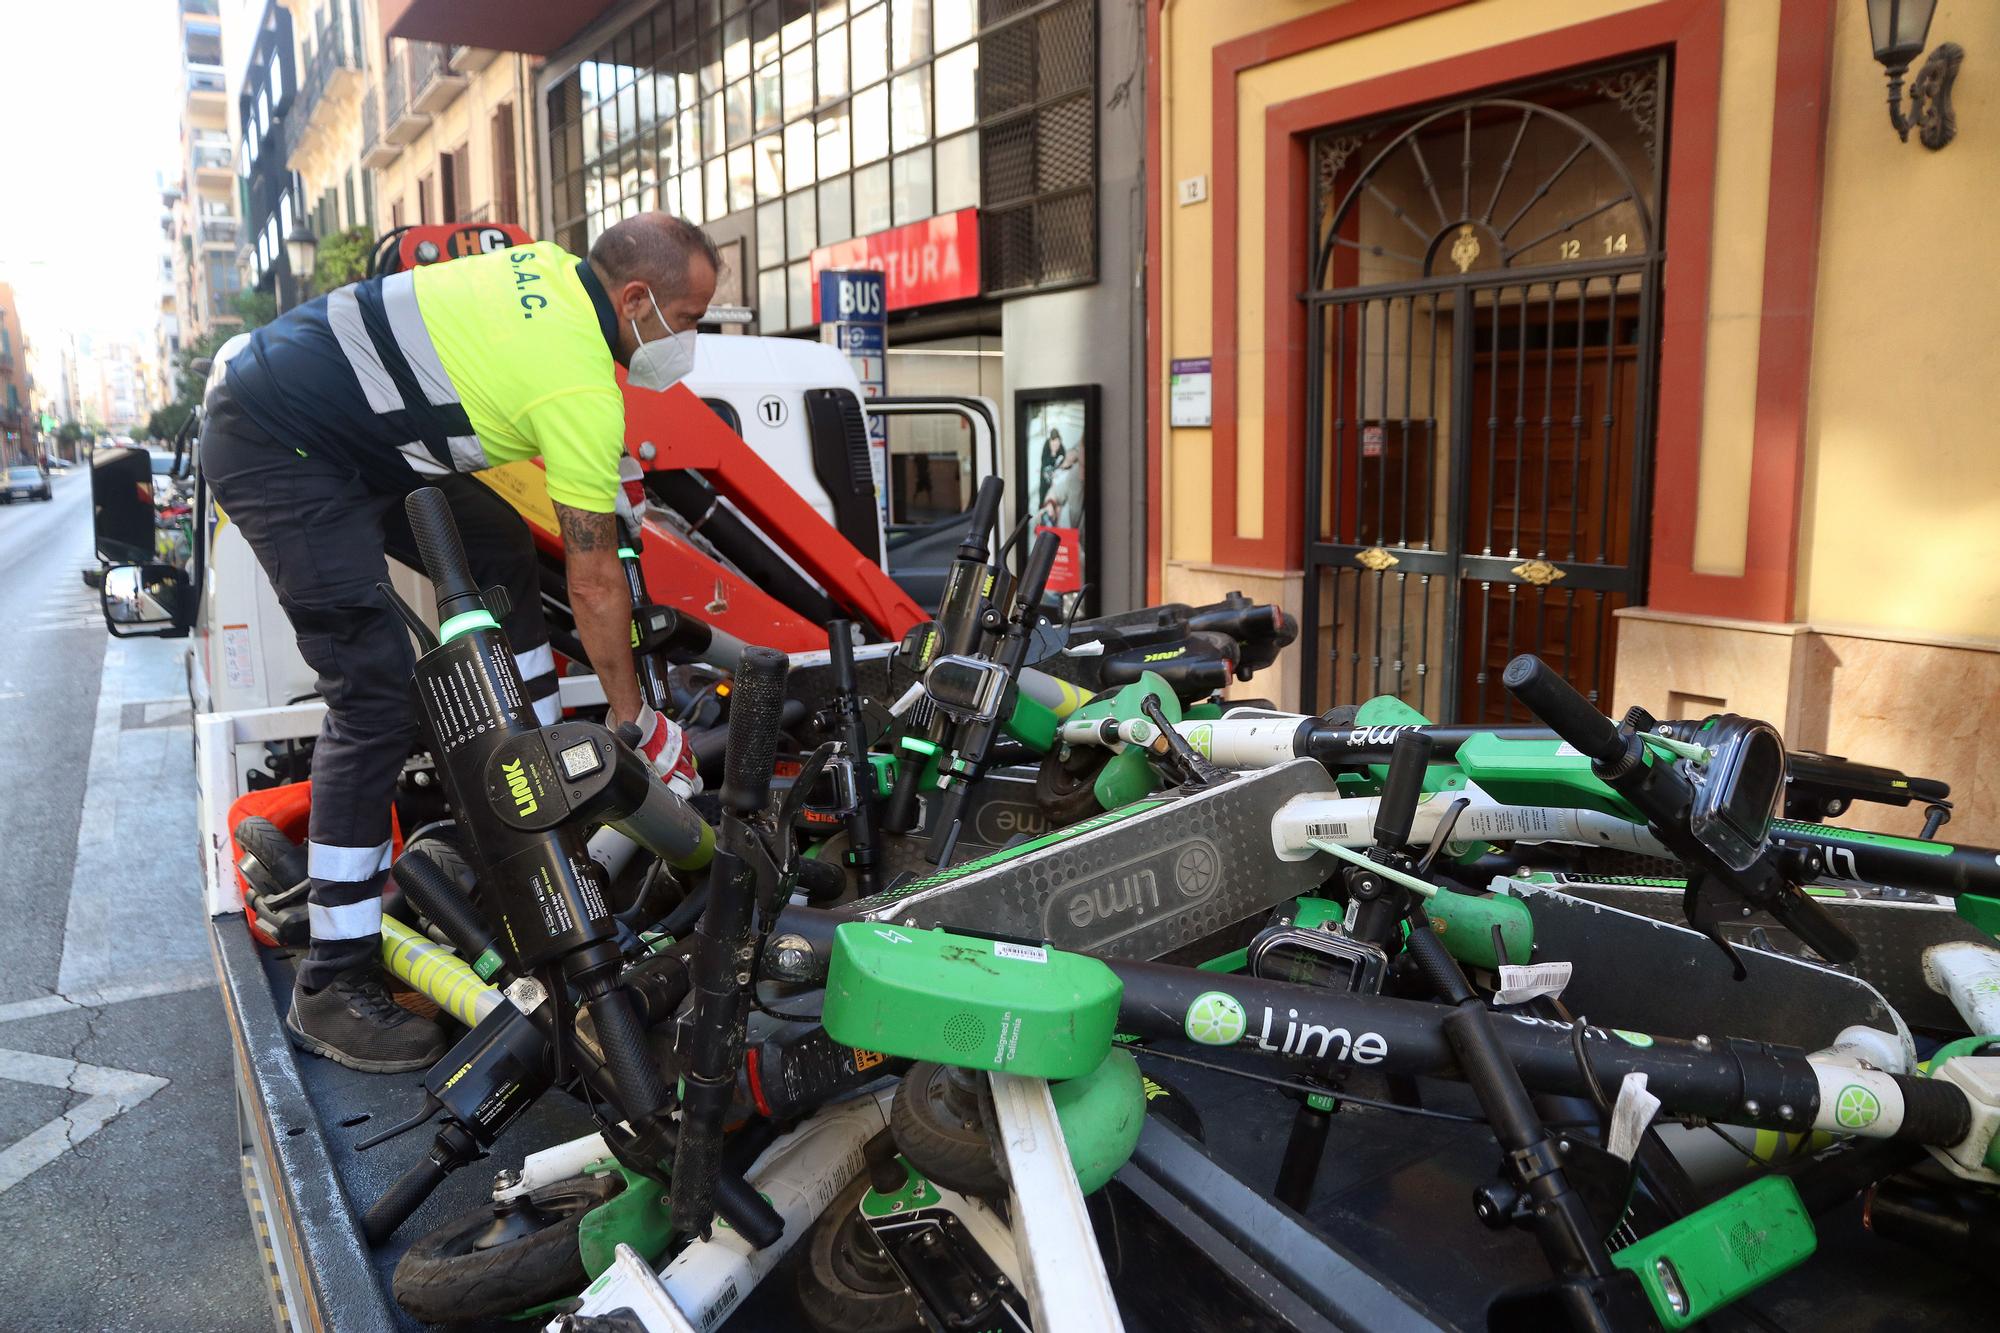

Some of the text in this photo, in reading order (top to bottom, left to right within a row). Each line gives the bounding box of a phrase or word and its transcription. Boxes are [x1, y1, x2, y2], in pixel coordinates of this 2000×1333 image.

[455, 229, 505, 257] HC
[1560, 233, 1628, 260] 12 14
[510, 252, 547, 319] S.A.C.
[838, 280, 881, 315] BUS
[861, 359, 869, 380] 1
[763, 401, 781, 421] 17
[981, 574, 995, 597] LINK
[920, 630, 936, 662] LINK
[1144, 646, 1187, 662] LINK
[500, 757, 539, 817] LINK
[1068, 869, 1160, 929] Lime
[994, 1011, 1012, 1063] Designed in
[1006, 1018, 1022, 1061] California
[1258, 1006, 1388, 1064] Lime
[444, 1061, 472, 1088] LINK
